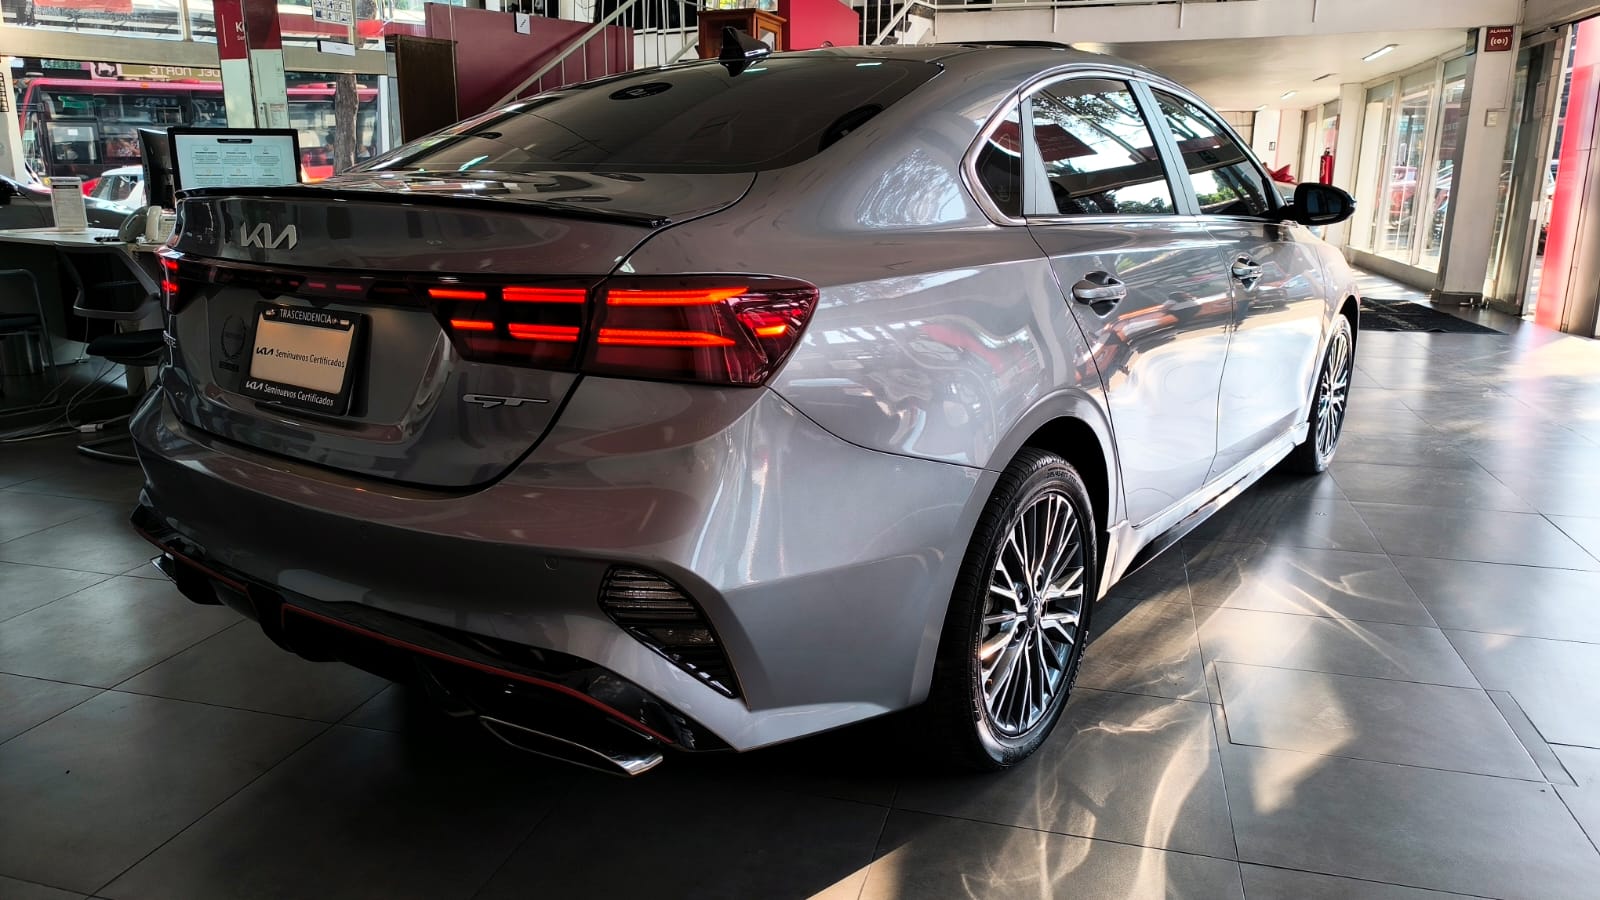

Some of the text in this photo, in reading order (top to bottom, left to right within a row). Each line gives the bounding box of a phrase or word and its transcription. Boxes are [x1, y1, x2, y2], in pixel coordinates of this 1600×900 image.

[240, 221, 296, 249] KIA
[280, 308, 332, 324] TRASCENDENCIA
[256, 346, 345, 368] KIA Seminuevos Certificados
[246, 381, 334, 406] KIA Seminuevos Certificados
[463, 394, 548, 408] GT
